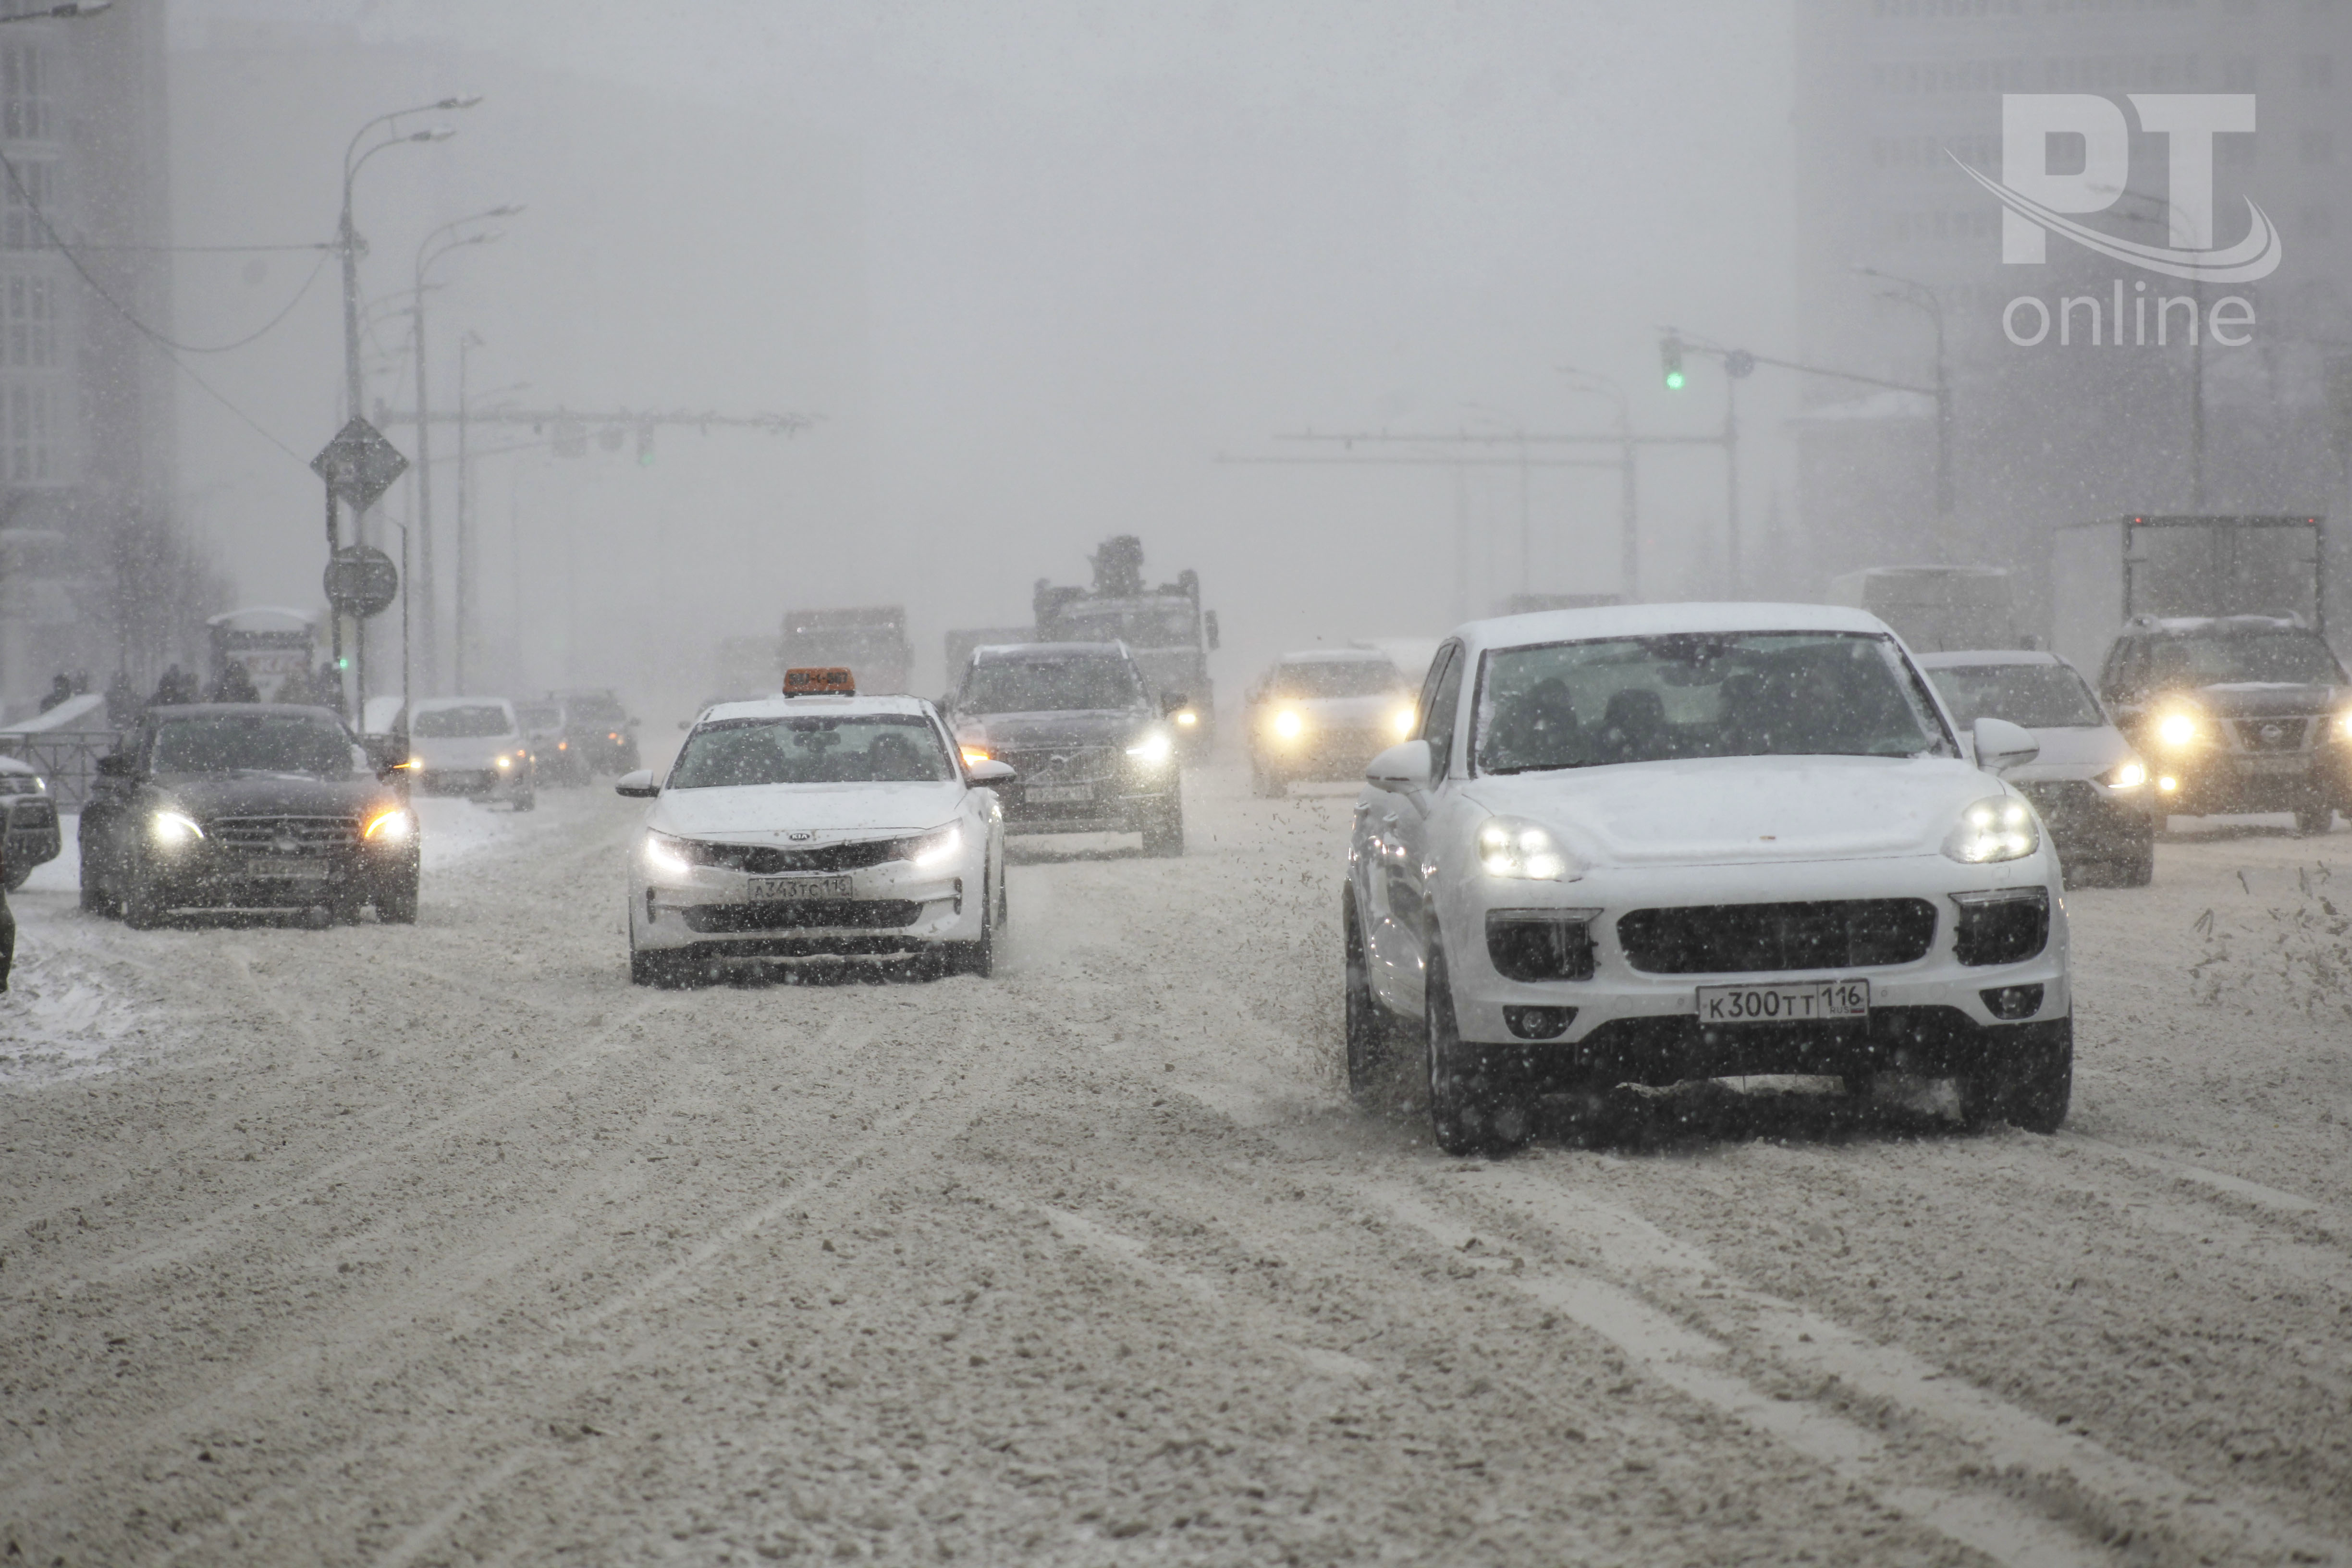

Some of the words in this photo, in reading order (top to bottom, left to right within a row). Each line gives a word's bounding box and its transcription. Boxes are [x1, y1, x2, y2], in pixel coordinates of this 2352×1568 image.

[1709, 991, 1814, 1018] К300ТТ
[1821, 985, 1861, 1007] 116
[1829, 1005, 1850, 1015] RUS
